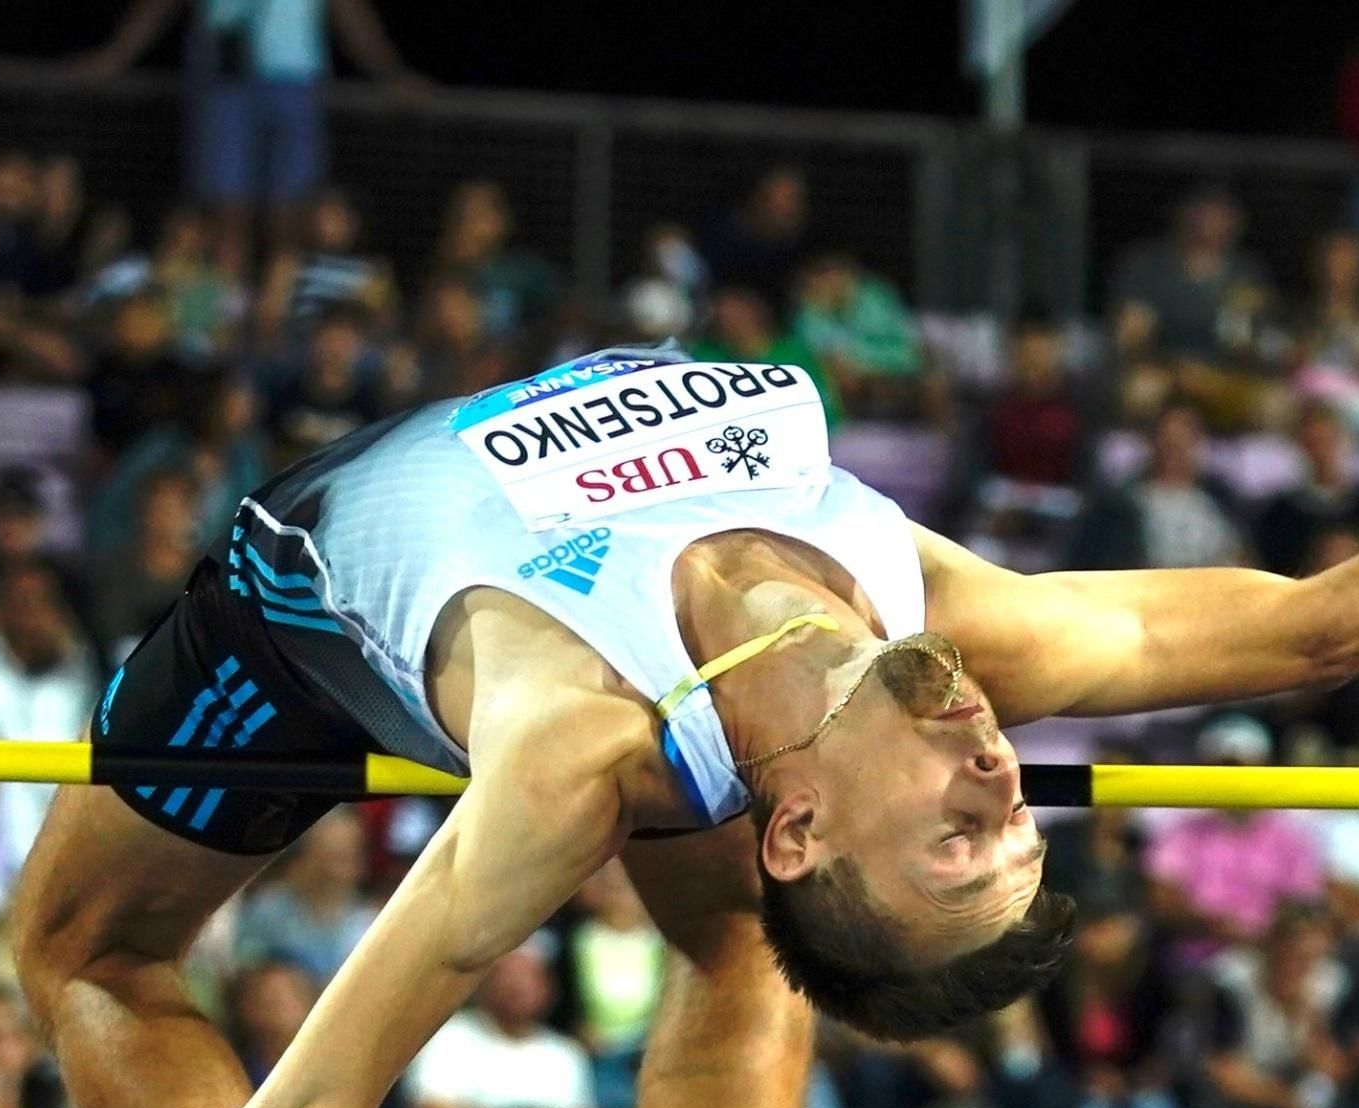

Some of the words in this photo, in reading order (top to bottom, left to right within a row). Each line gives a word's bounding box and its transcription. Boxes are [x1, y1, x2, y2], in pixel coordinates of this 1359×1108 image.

[484, 364, 798, 467] PROTSENKO
[574, 446, 709, 502] UBS
[517, 527, 611, 579] adidas
